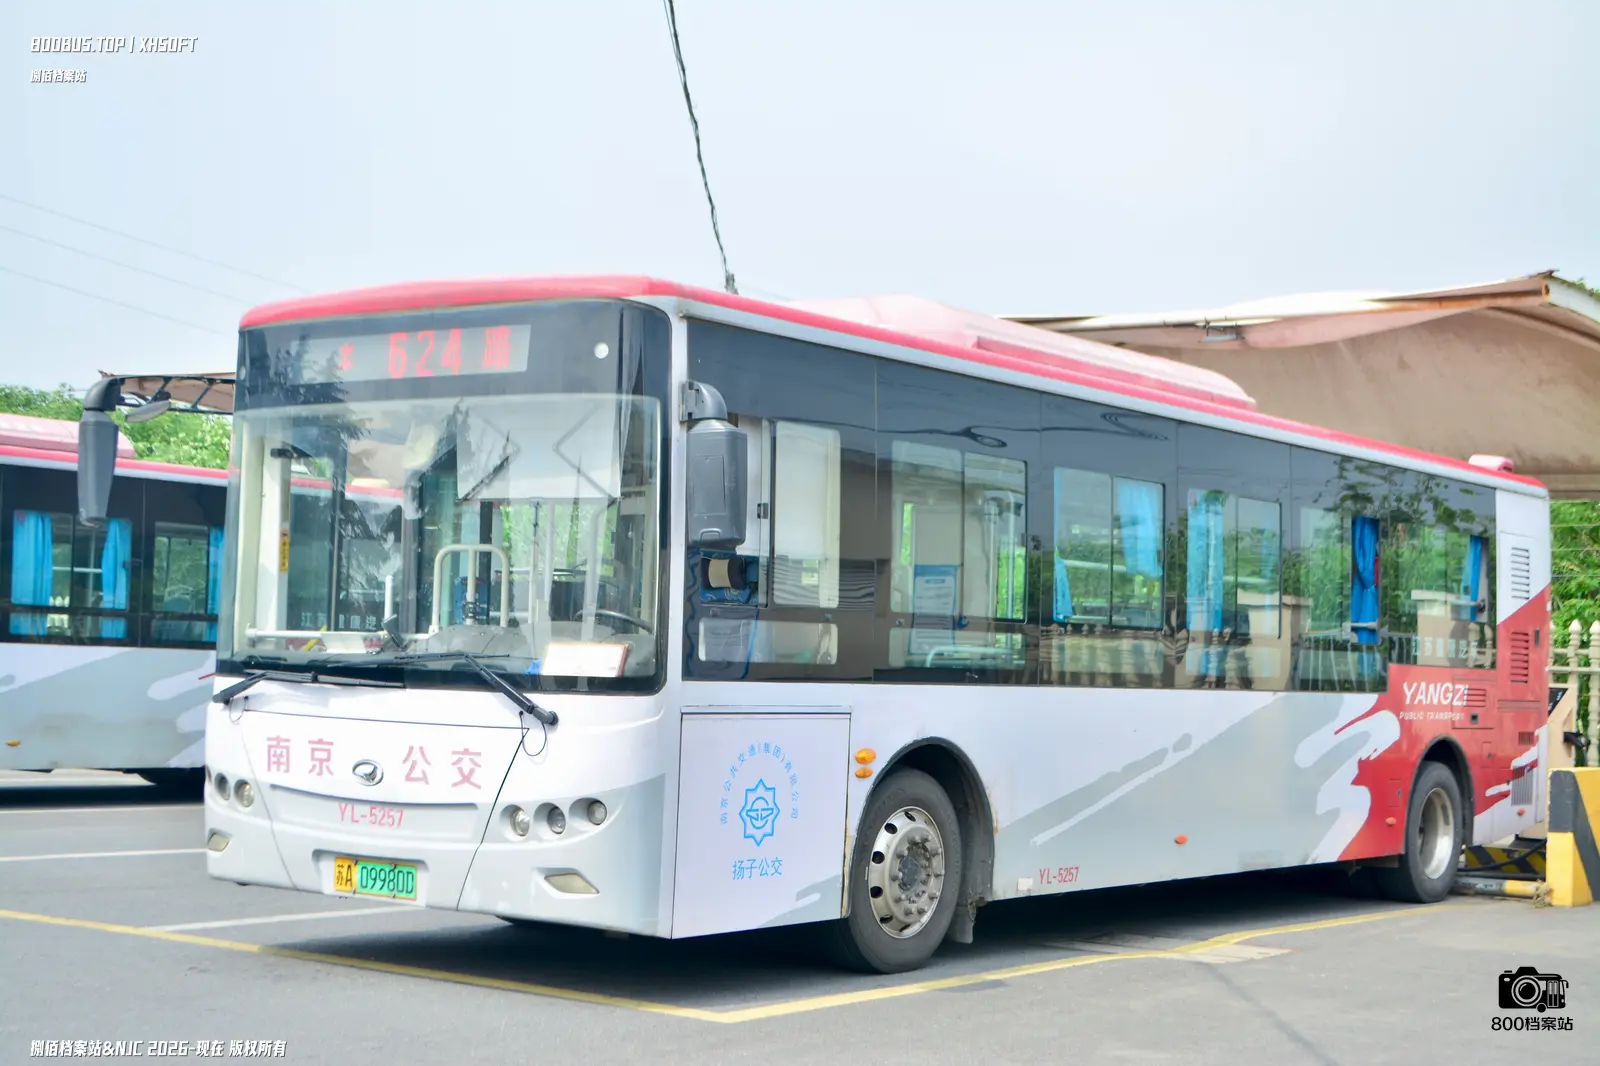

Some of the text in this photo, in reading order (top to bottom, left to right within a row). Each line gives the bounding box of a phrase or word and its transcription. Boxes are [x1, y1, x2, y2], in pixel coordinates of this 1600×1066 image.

[388, 328, 462, 379] 624
[1403, 681, 1469, 706] YANGZI
[1400, 711, 1465, 721] PUBLIC TRANSPORT
[338, 802, 405, 828] YL-5257
[732, 856, 783, 880] 扬子公交
[1039, 866, 1080, 885] YL-5257
